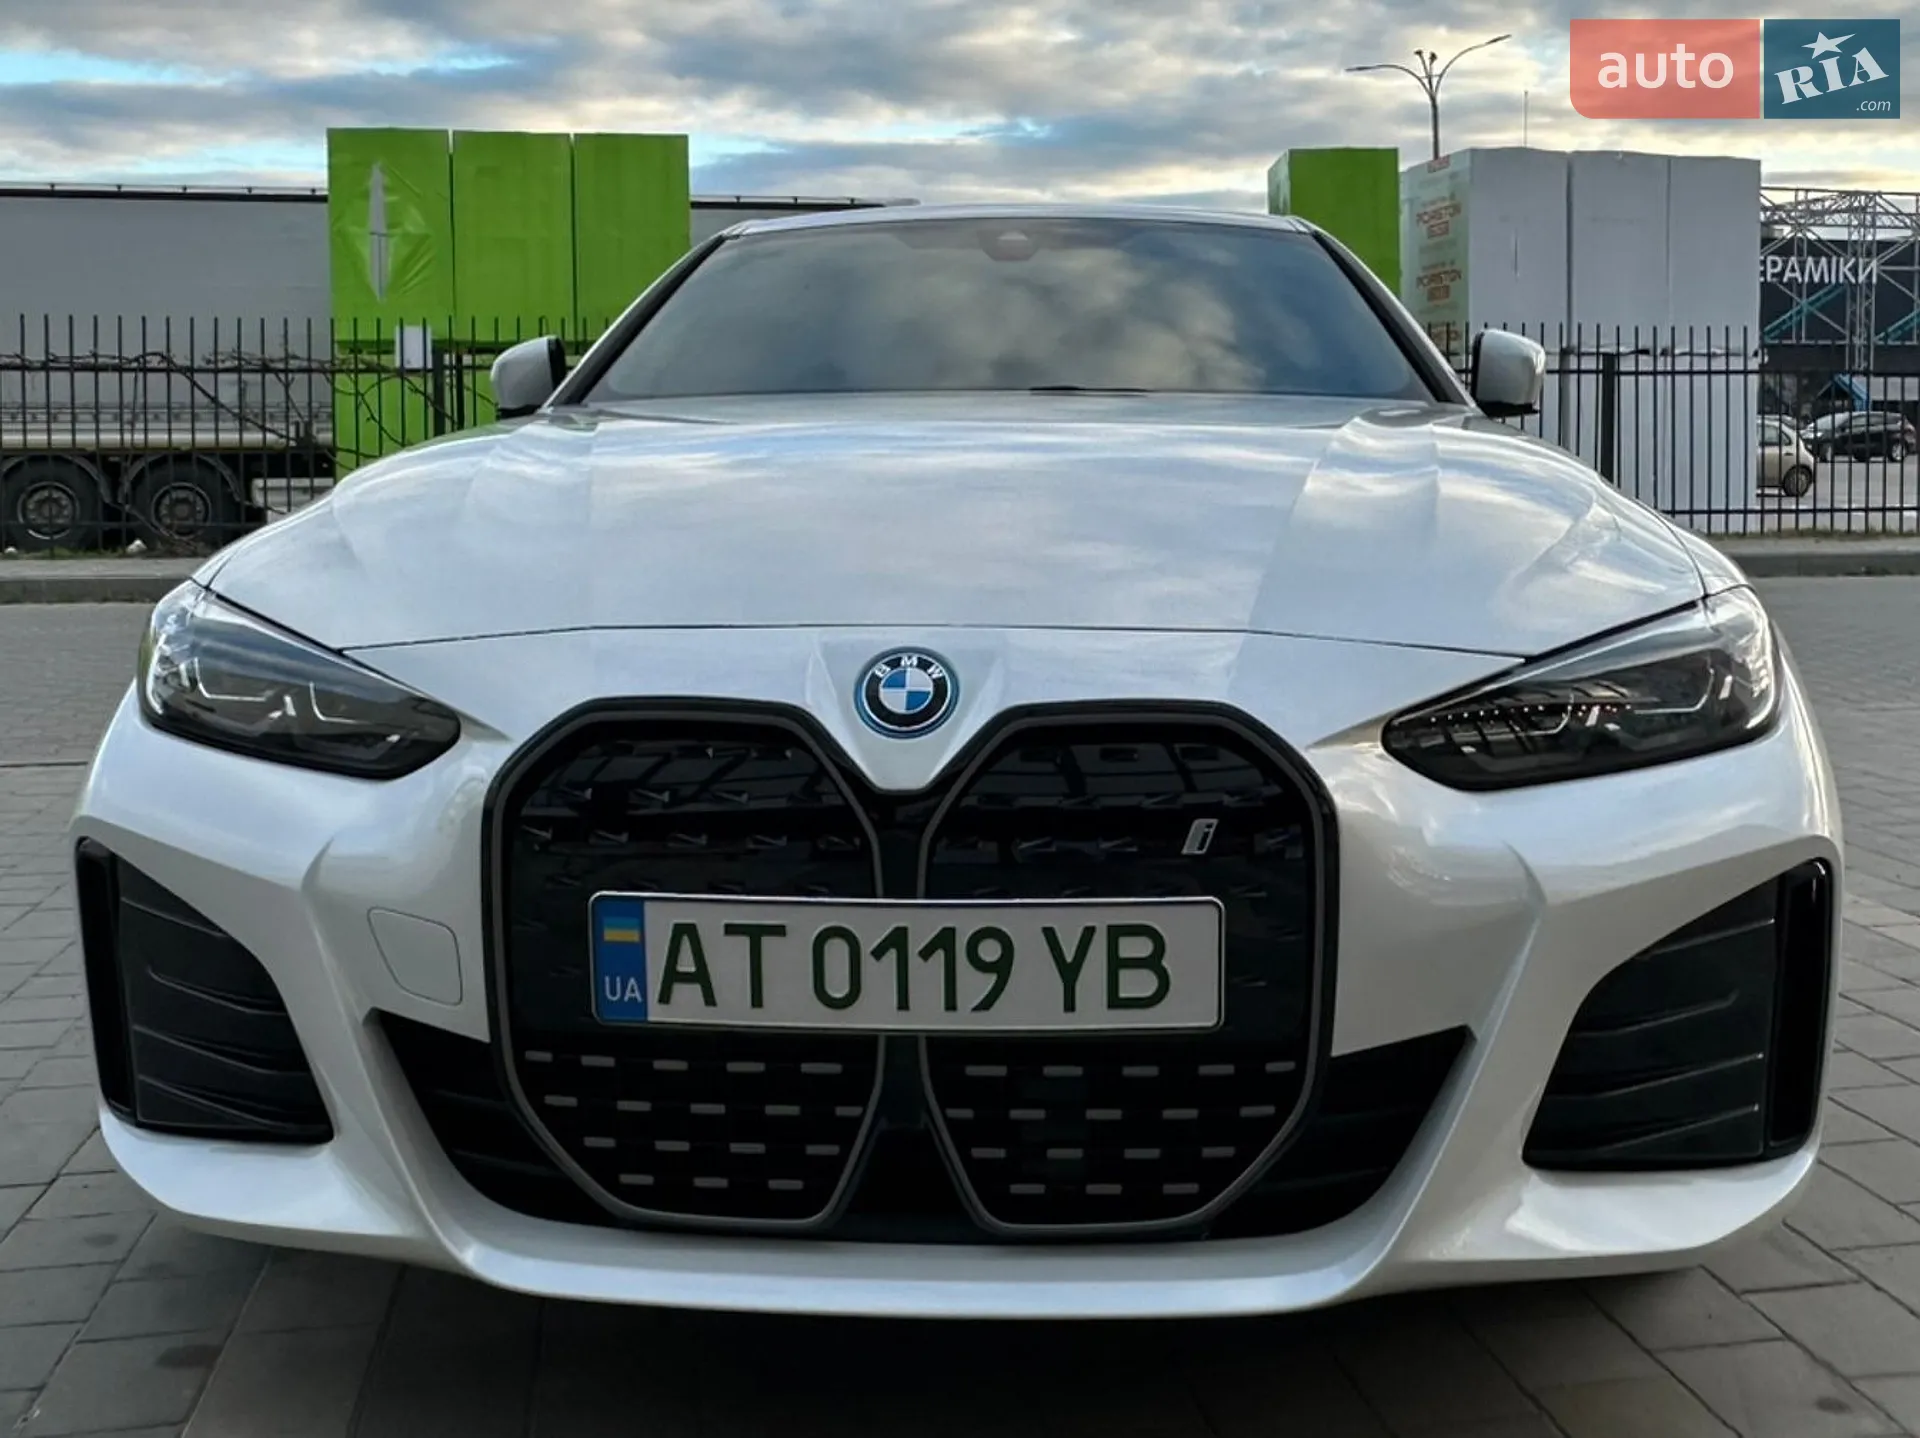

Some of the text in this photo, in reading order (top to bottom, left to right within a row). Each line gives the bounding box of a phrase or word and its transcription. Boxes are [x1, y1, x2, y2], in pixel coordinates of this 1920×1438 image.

[874, 655, 944, 679] BMW
[657, 922, 1171, 1014] AT 0119 YB
[604, 975, 642, 1003] UA
